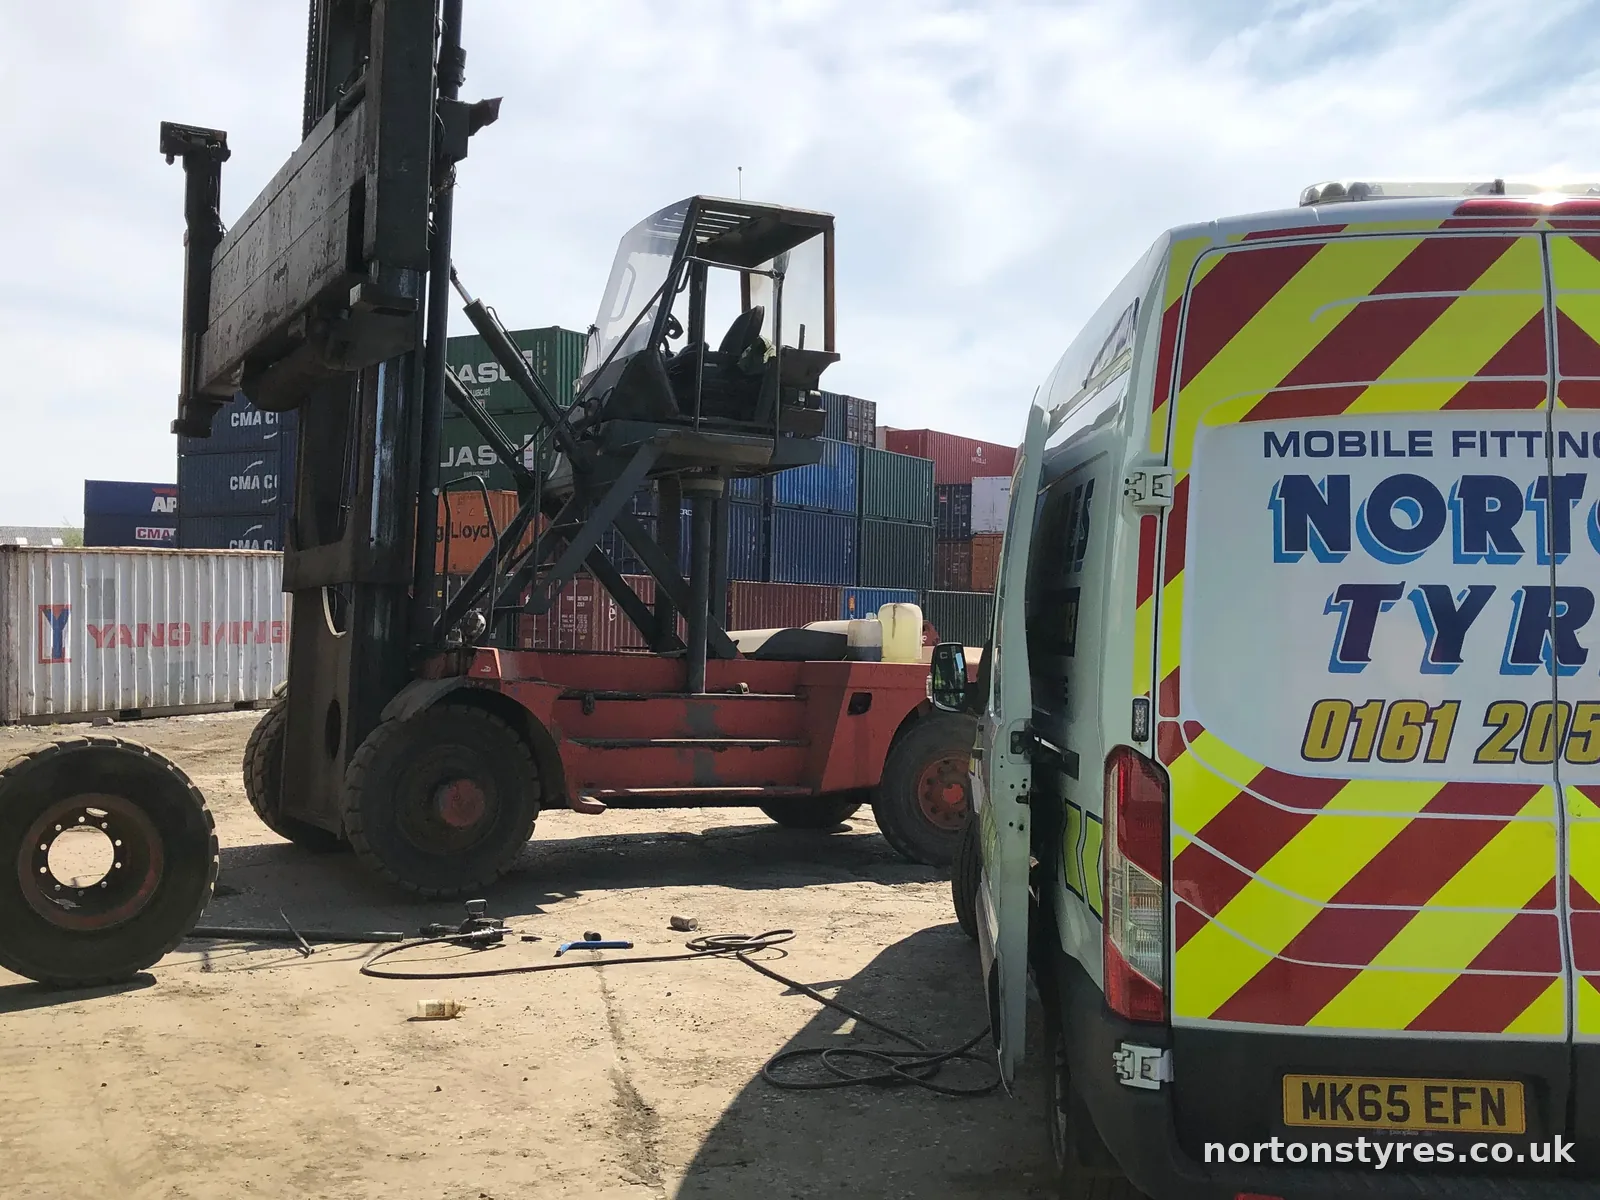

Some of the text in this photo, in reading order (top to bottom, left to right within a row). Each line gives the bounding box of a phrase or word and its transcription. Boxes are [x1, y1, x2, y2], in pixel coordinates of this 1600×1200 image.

[231, 411, 279, 427] CMA C
[1264, 430, 1600, 459] MOBILE FITTIN
[230, 474, 278, 490] CMA C
[151, 496, 177, 513] AP
[451, 521, 490, 542] Lloyd
[1268, 472, 1600, 566] NORT
[137, 528, 172, 540] CMA
[229, 539, 260, 550] CMA
[87, 620, 290, 649] YANG MING
[1323, 580, 1600, 675] TYR
[1301, 698, 1600, 765] 0161 205
[1300, 1081, 1507, 1127] MK65 EFN
